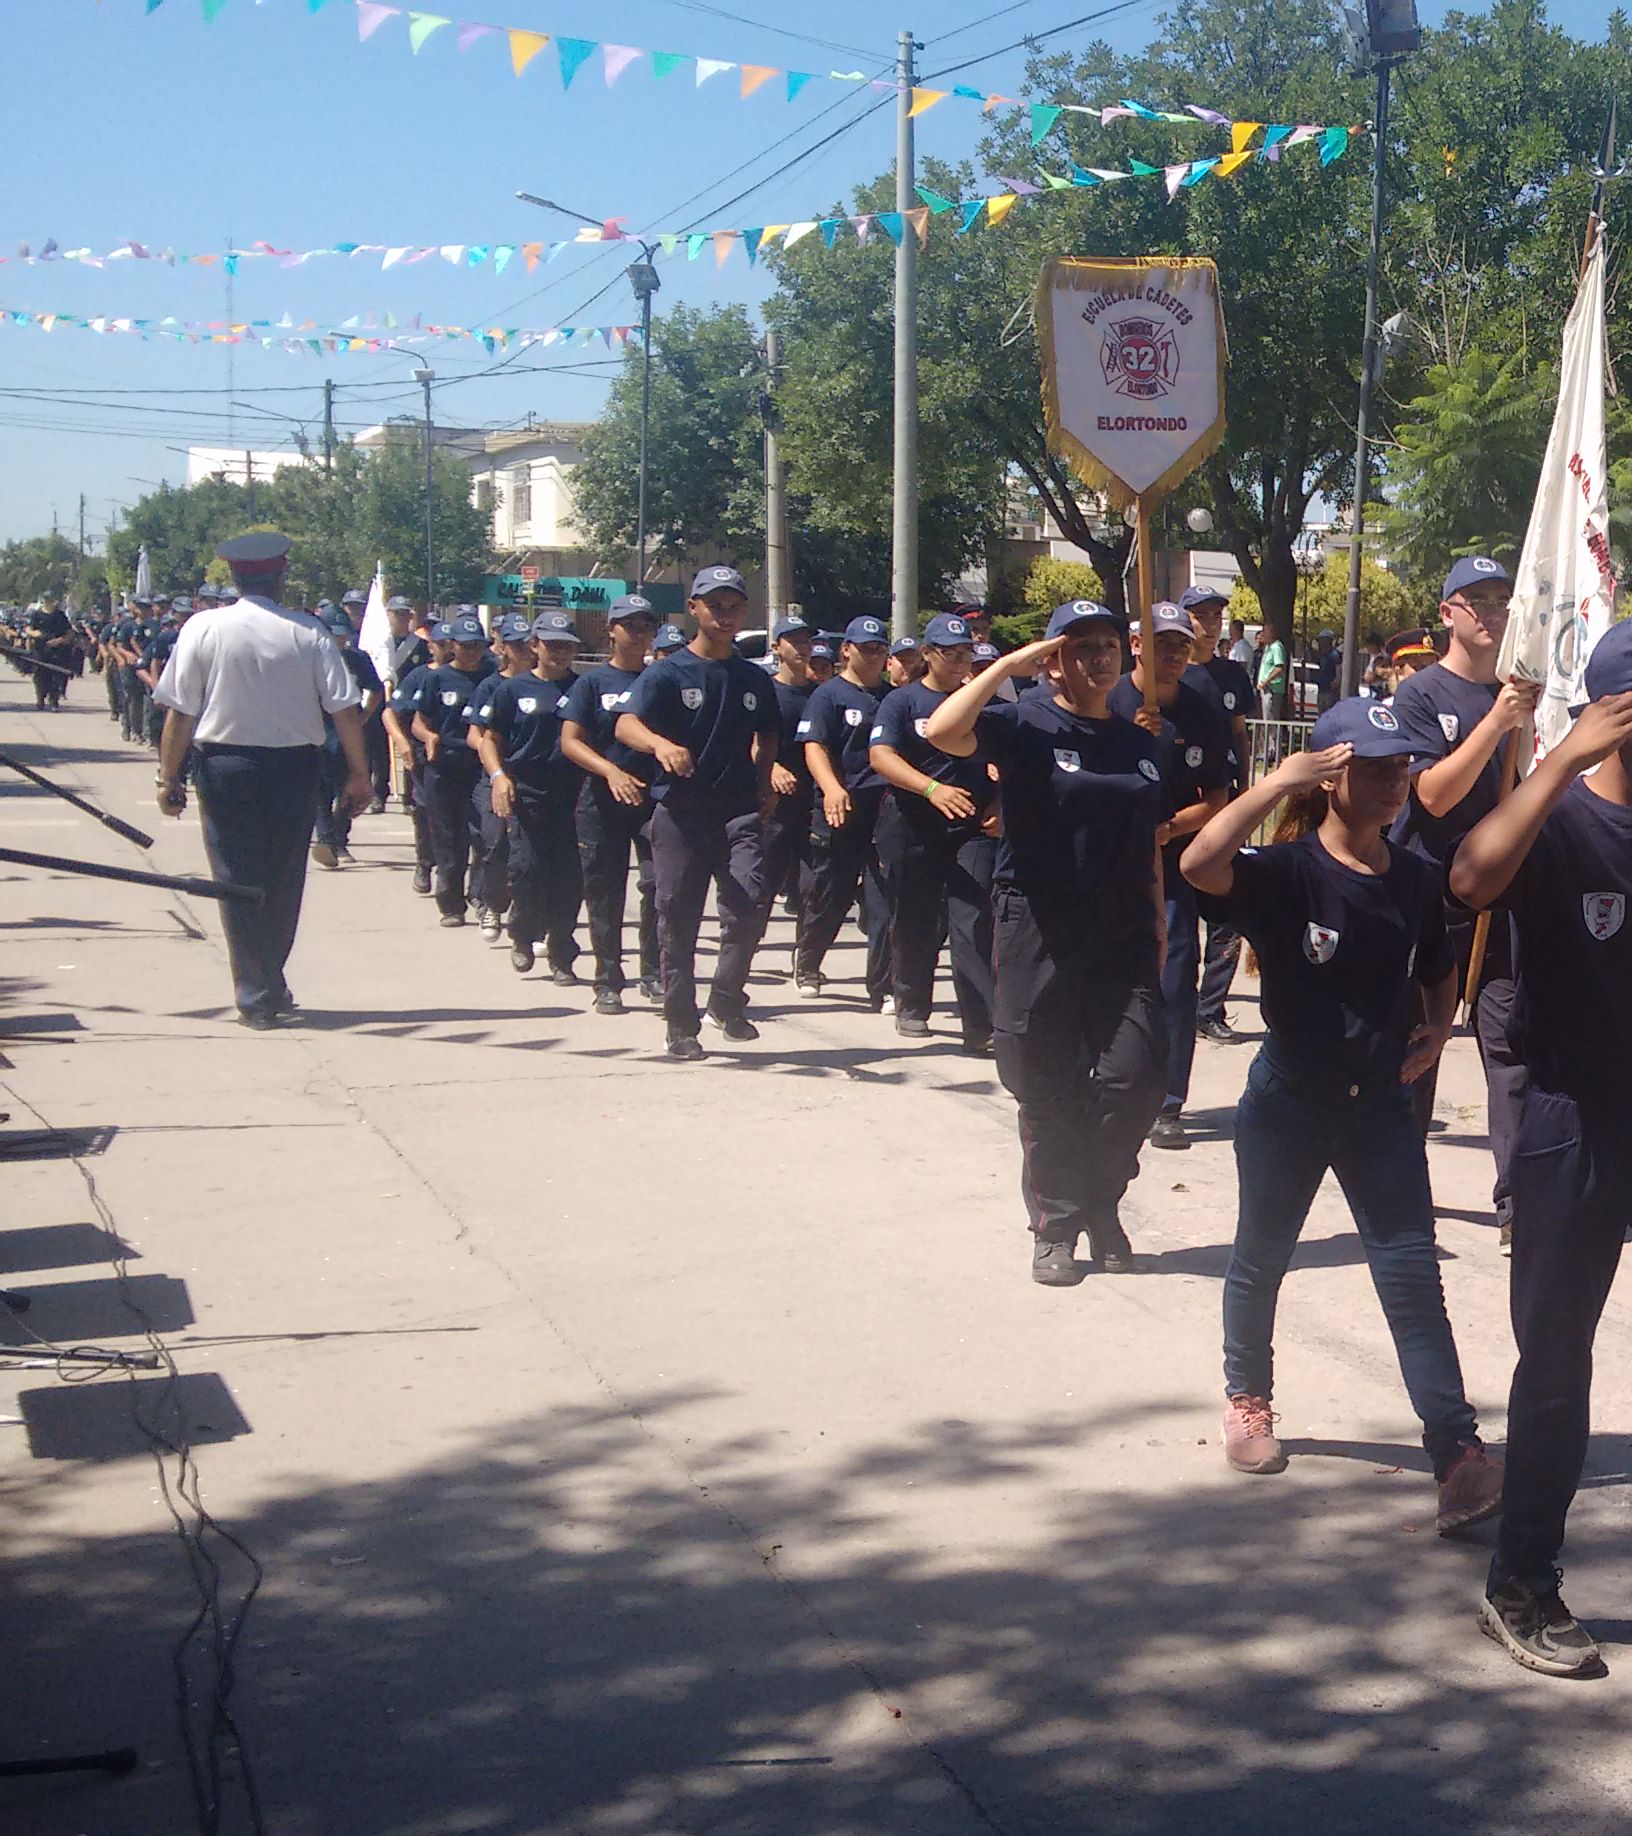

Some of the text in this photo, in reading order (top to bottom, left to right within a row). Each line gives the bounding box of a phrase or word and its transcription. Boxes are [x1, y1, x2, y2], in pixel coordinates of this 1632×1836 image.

[1146, 286, 1194, 326] CADETES
[1121, 346, 1156, 371] 32
[1097, 415, 1188, 432] ELORTONDO
